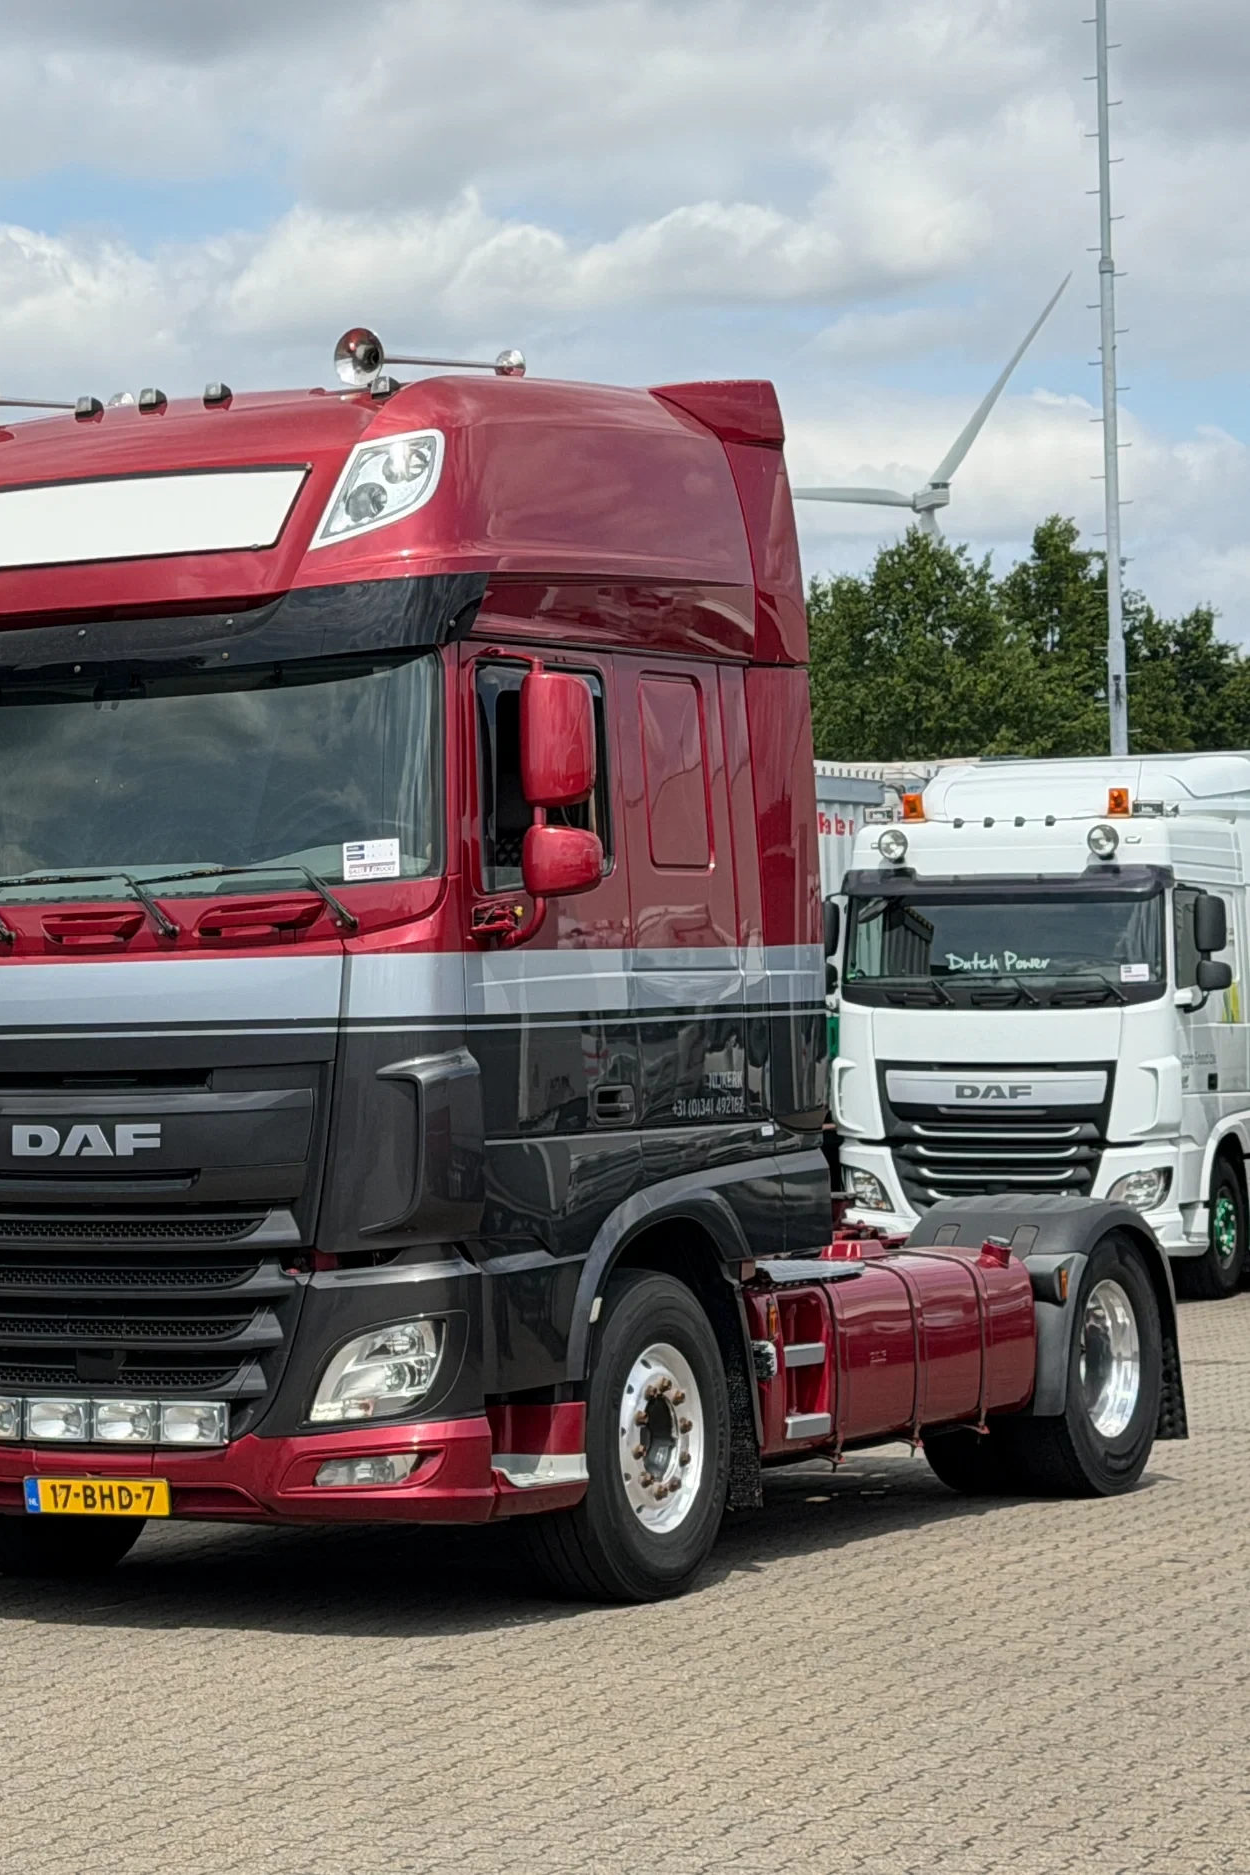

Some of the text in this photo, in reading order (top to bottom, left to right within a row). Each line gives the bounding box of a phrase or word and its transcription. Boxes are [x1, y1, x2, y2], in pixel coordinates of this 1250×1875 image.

[944, 950, 1050, 971] Dutch Power
[955, 1084, 1032, 1099] DAF
[672, 1096, 745, 1119] +31 (0)341 492162
[12, 1123, 161, 1156] DAF
[49, 1484, 155, 1512] 17-BHD-7
